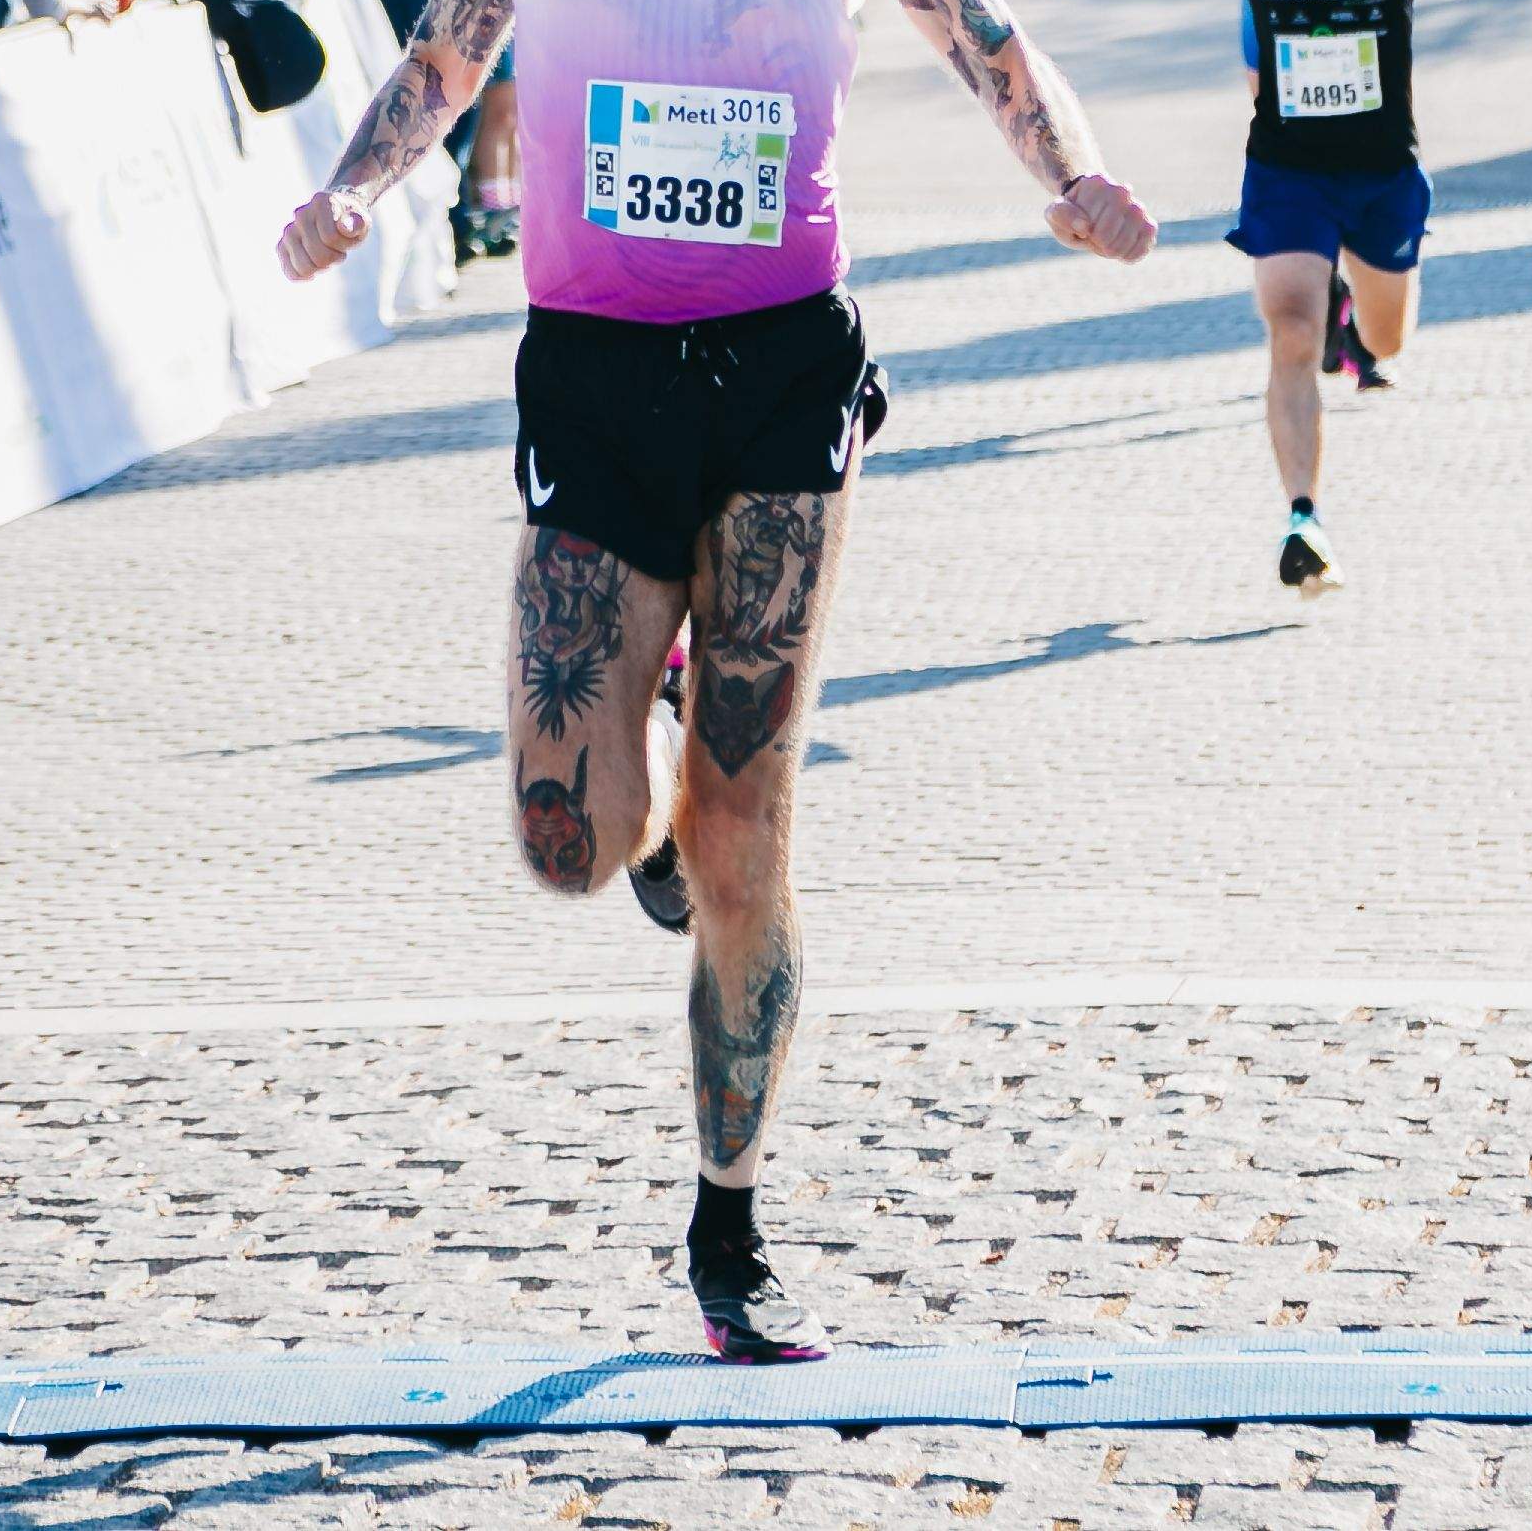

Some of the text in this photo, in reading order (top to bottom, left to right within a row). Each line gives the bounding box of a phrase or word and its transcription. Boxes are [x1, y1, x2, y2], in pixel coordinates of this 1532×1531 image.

[1300, 83, 1357, 107] 4895
[722, 98, 781, 125] 3016
[626, 174, 744, 228] 3338
